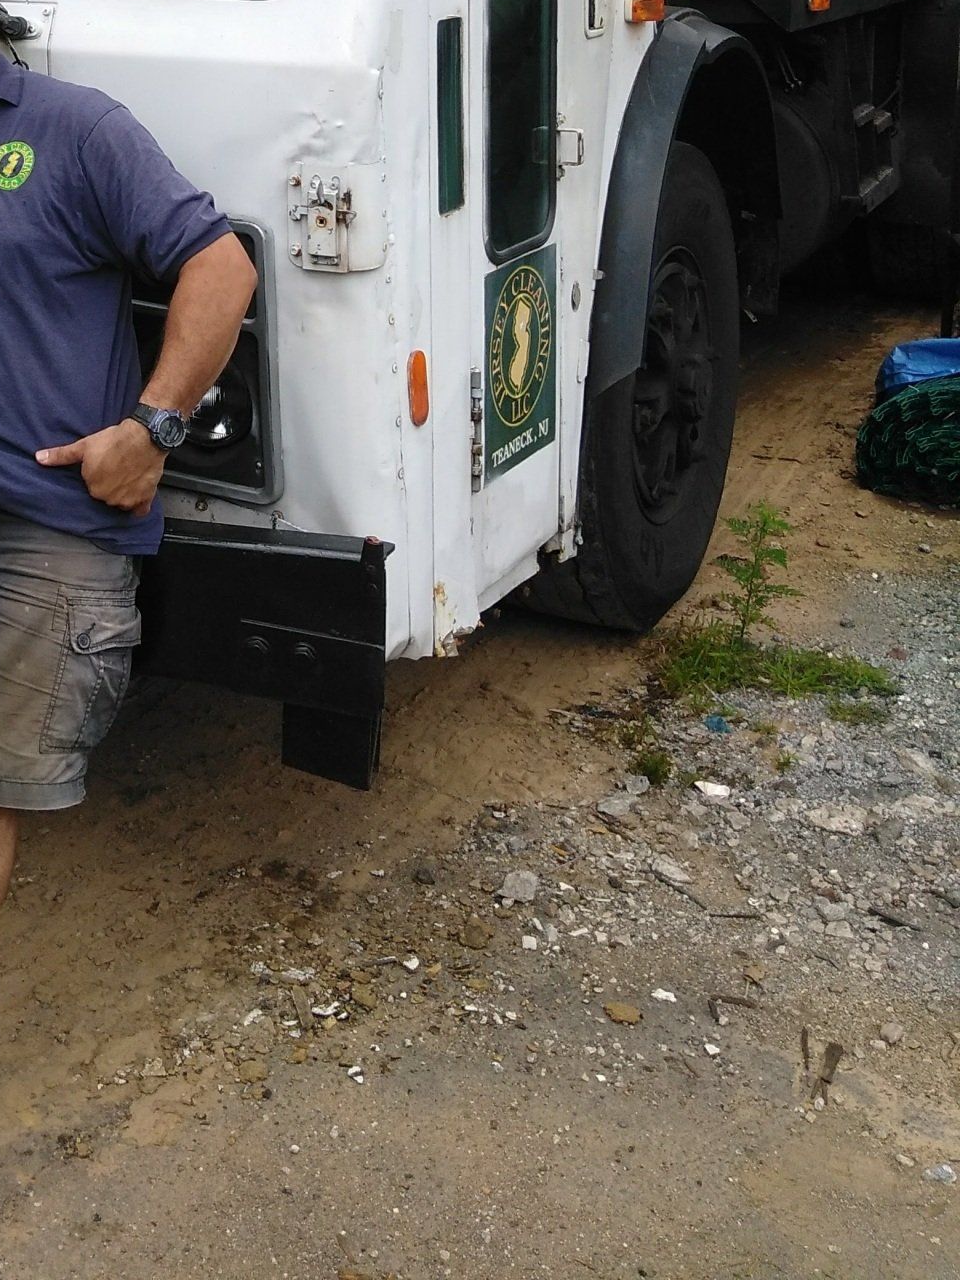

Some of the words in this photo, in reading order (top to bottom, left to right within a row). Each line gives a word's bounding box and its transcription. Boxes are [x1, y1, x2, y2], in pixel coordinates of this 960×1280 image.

[491, 294, 510, 409] JERSEY
[511, 272, 550, 382] CLEANING
[511, 392, 531, 422] LLC
[538, 418, 550, 438] NJ
